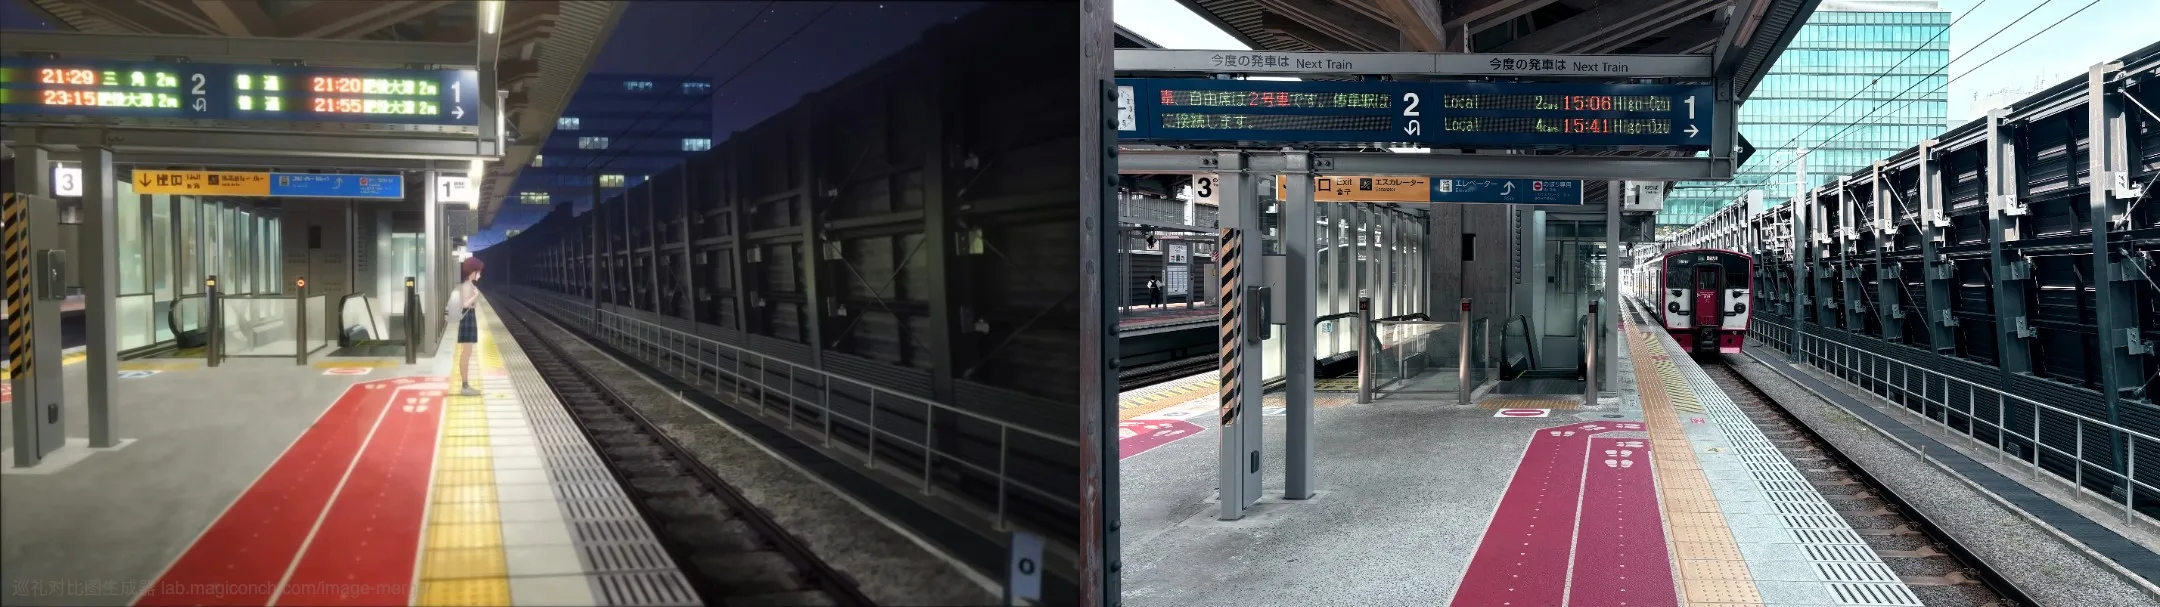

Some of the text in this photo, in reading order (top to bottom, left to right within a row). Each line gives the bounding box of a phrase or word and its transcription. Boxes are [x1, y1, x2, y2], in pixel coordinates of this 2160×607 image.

[1211, 54, 1290, 68] 今度の発車は
[1296, 59, 1353, 70] Next Train
[1489, 57, 1567, 71] 今度の発車は
[1573, 61, 1629, 72] Next Train
[42, 69, 94, 84] 21:29
[191, 74, 206, 94] 2
[314, 77, 361, 92] 21:20
[451, 82, 461, 102] 1
[44, 90, 95, 105] 23:15
[1403, 93, 1419, 116] 2
[1444, 95, 1478, 109] Local
[1564, 96, 1611, 110] 15:06
[314, 99, 361, 113] 21:55
[1684, 96, 1695, 119] 1
[1445, 117, 1479, 131] Local
[1564, 119, 1609, 133] 15:41
[62, 174, 74, 191] 3
[442, 181, 451, 198] 1
[1197, 177, 1212, 198] 3
[1336, 178, 1352, 186] Exit
[1455, 180, 1498, 188] エレベーター
[1630, 184, 1640, 205] 1
